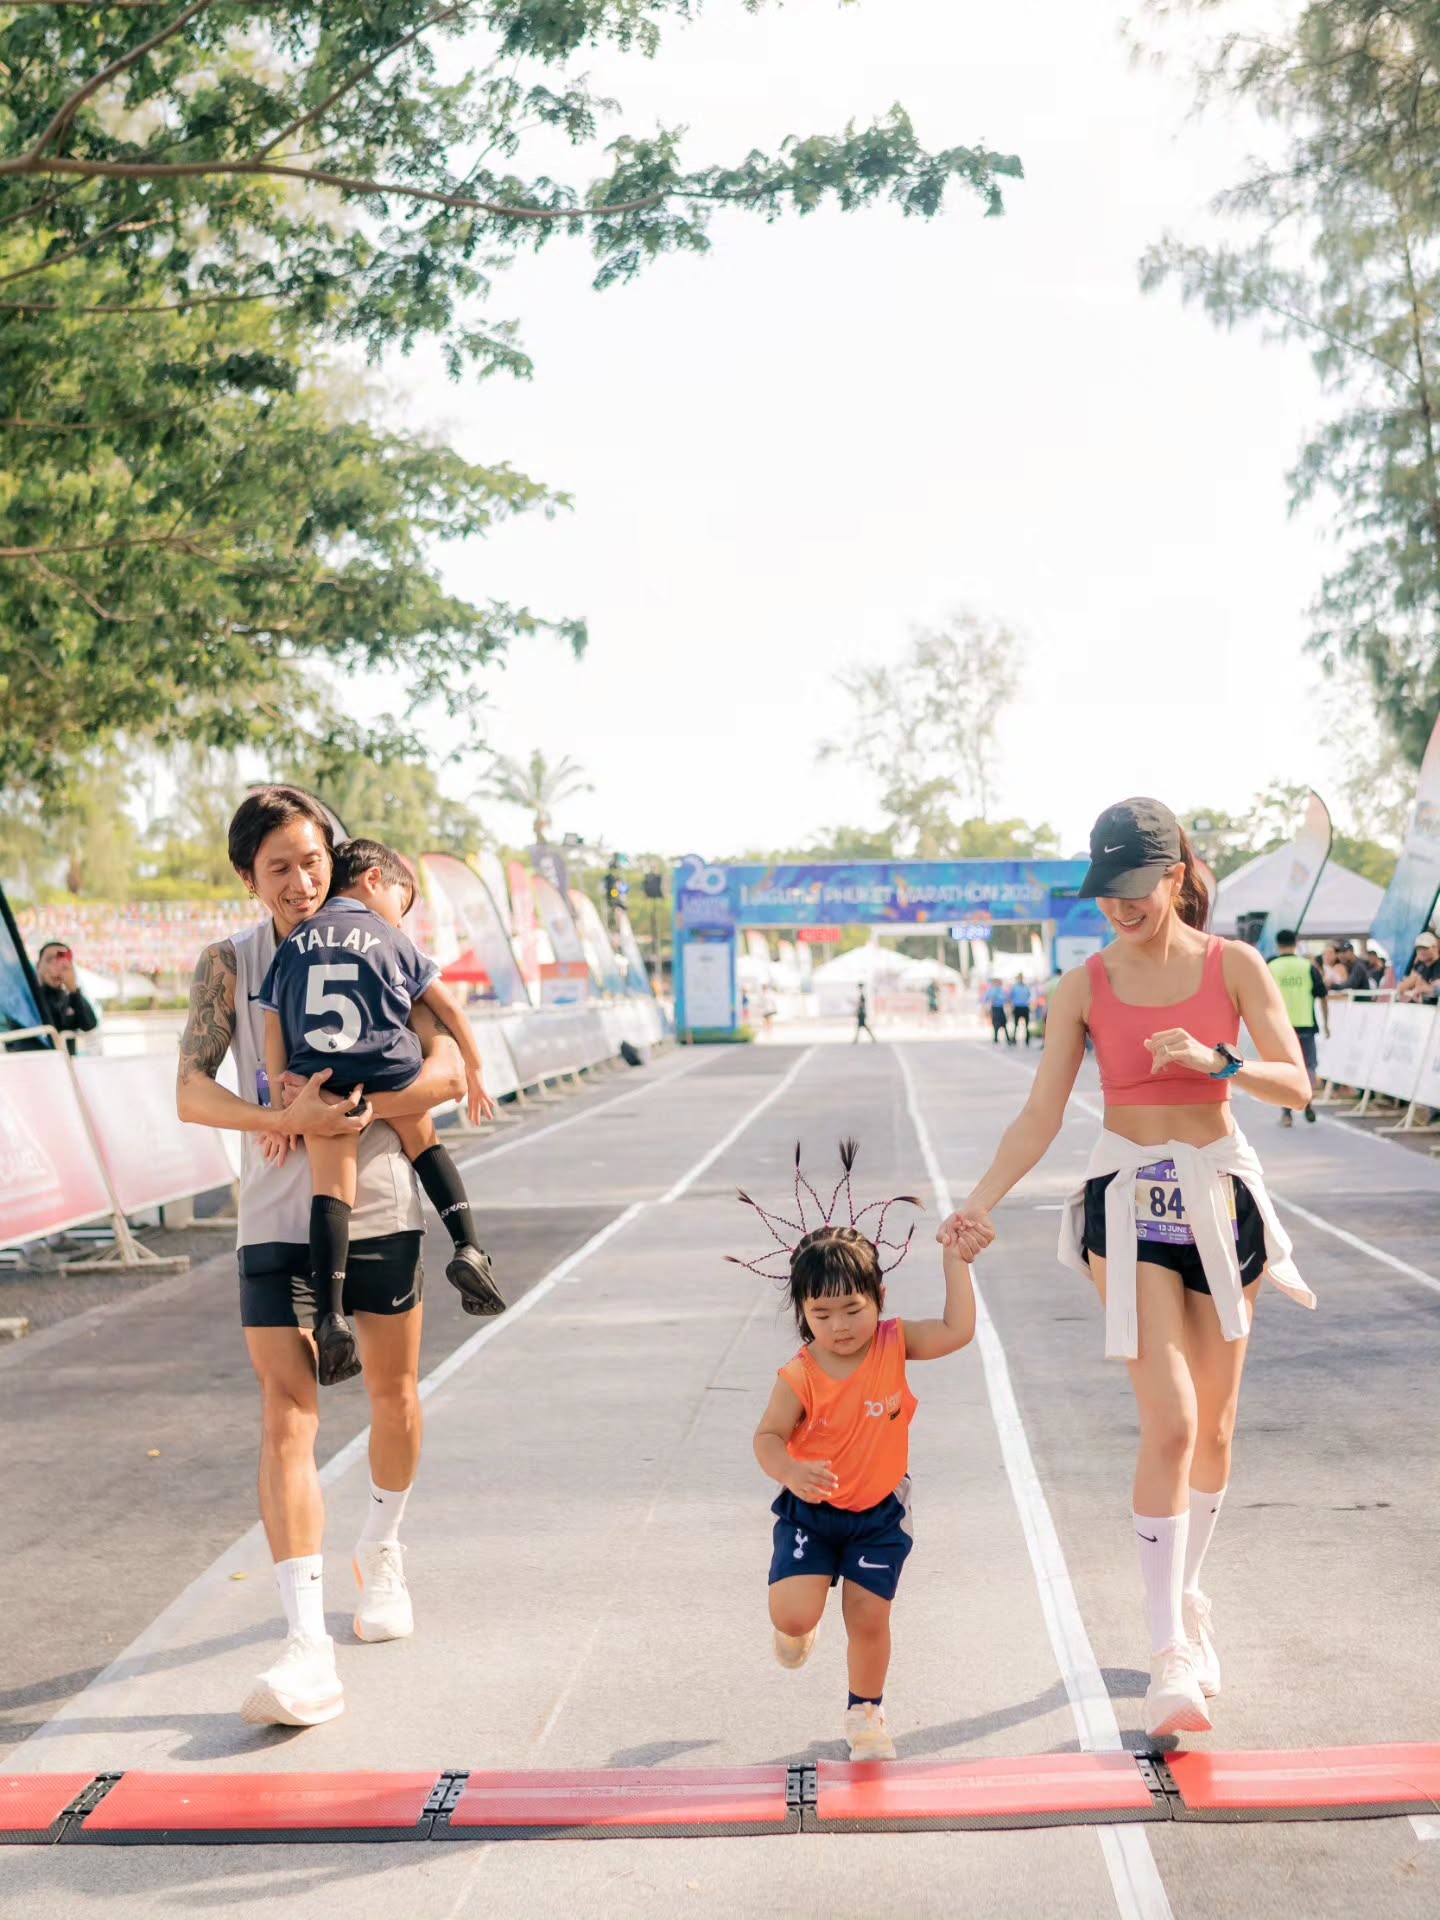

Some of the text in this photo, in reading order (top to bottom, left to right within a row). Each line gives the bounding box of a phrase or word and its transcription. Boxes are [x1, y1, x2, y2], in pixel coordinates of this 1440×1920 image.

[291, 926, 381, 955] TALAY
[304, 964, 361, 1053] 5
[1150, 1186, 1185, 1219] 84
[1167, 1225, 1188, 1234] JUNE
